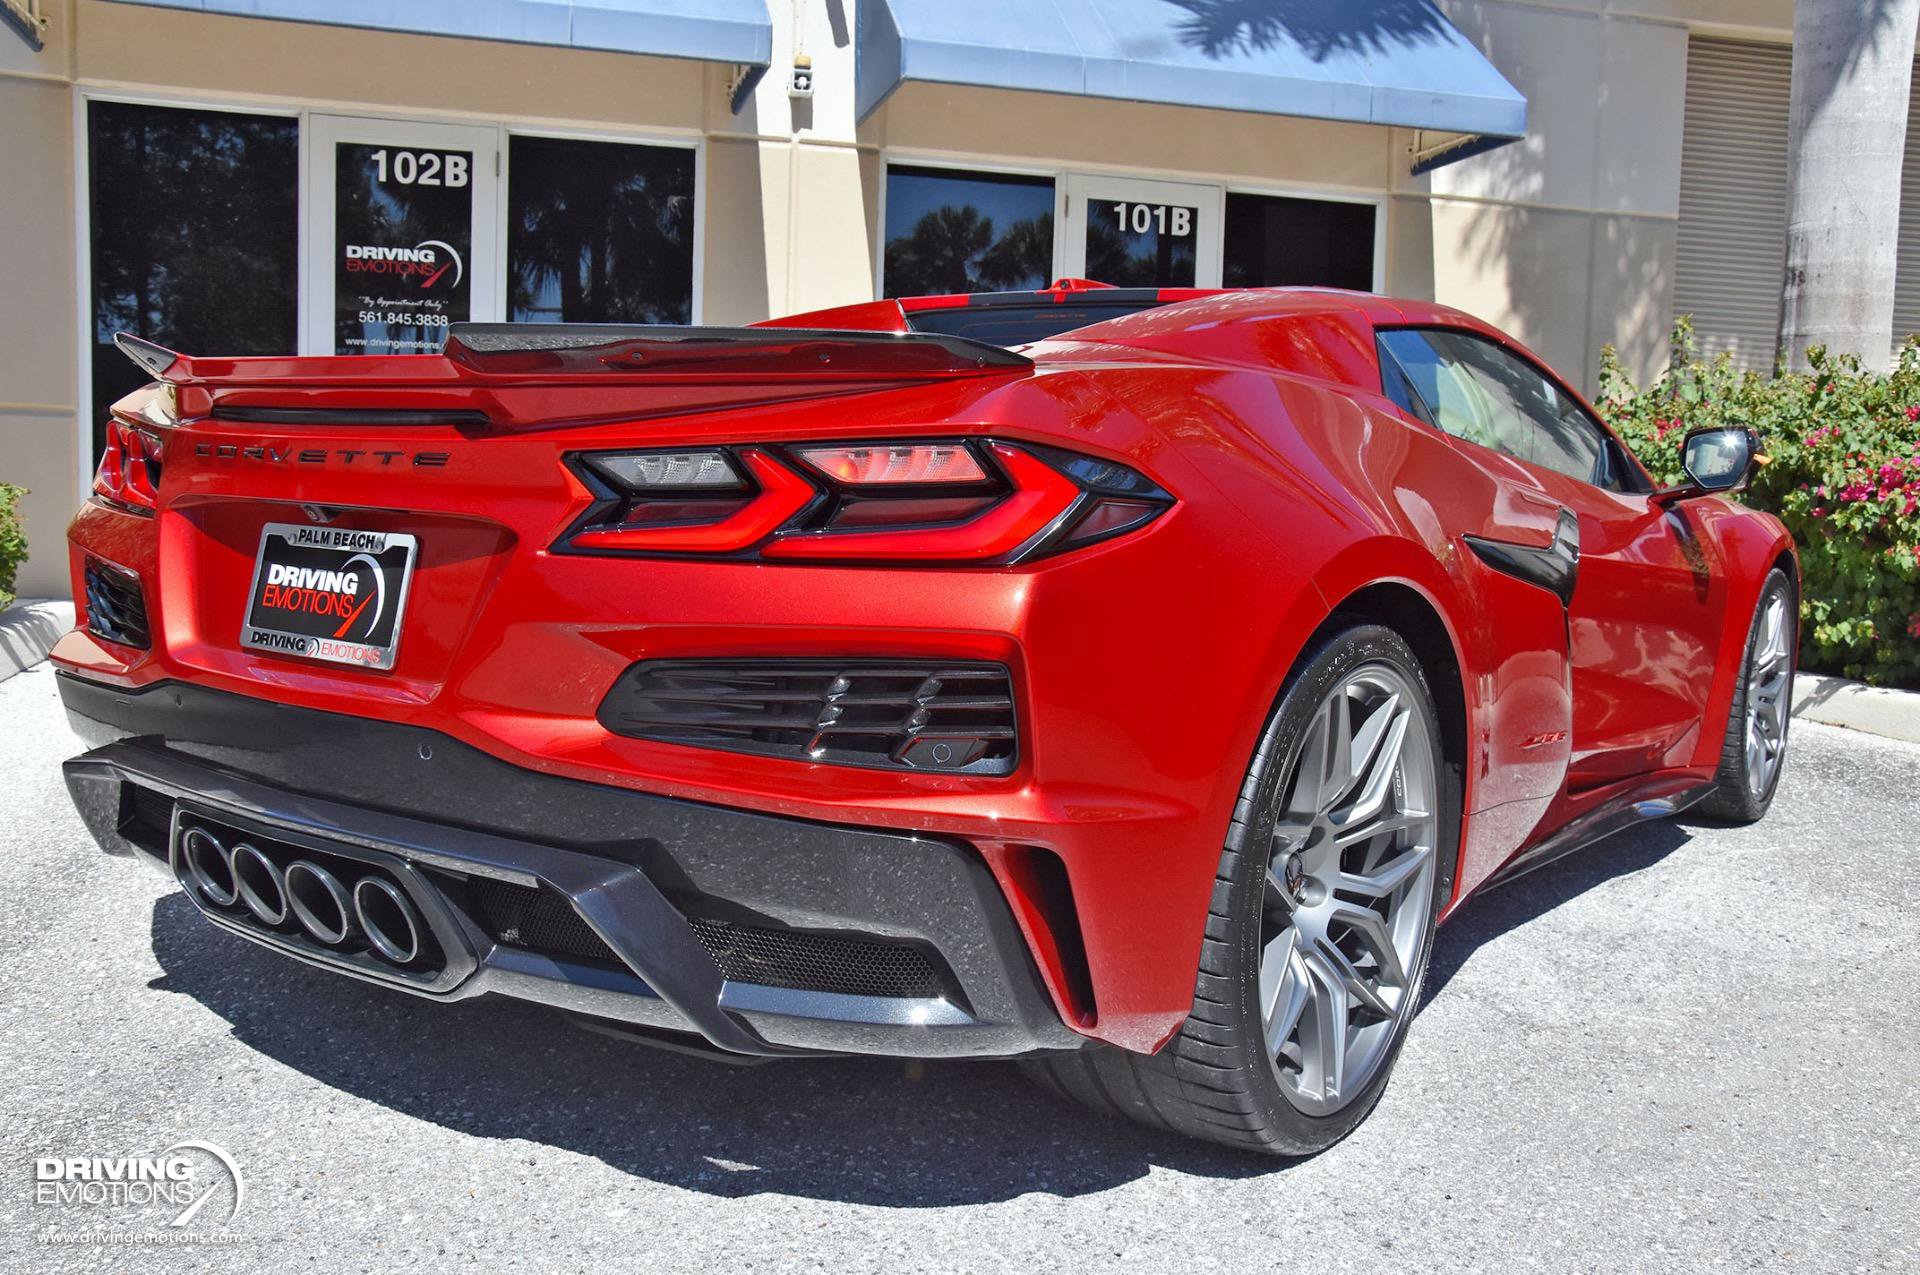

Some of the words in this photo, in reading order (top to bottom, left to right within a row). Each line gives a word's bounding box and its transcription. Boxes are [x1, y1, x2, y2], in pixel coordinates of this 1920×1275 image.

[371, 149, 468, 188] 102B
[1113, 202, 1191, 237] 101B
[346, 245, 435, 263] DRIVING
[346, 259, 436, 277] EMOTIONS
[376, 296, 423, 308] Appointment
[358, 310, 449, 327] 561.845.3838
[194, 443, 451, 467] CORVETTE
[298, 528, 331, 545] PALM
[333, 531, 376, 549] BEACH
[267, 563, 359, 595] DRIVING
[262, 585, 356, 618] EMOTIONS
[250, 631, 306, 652] DRIVING
[320, 641, 382, 664] EMOTIONS
